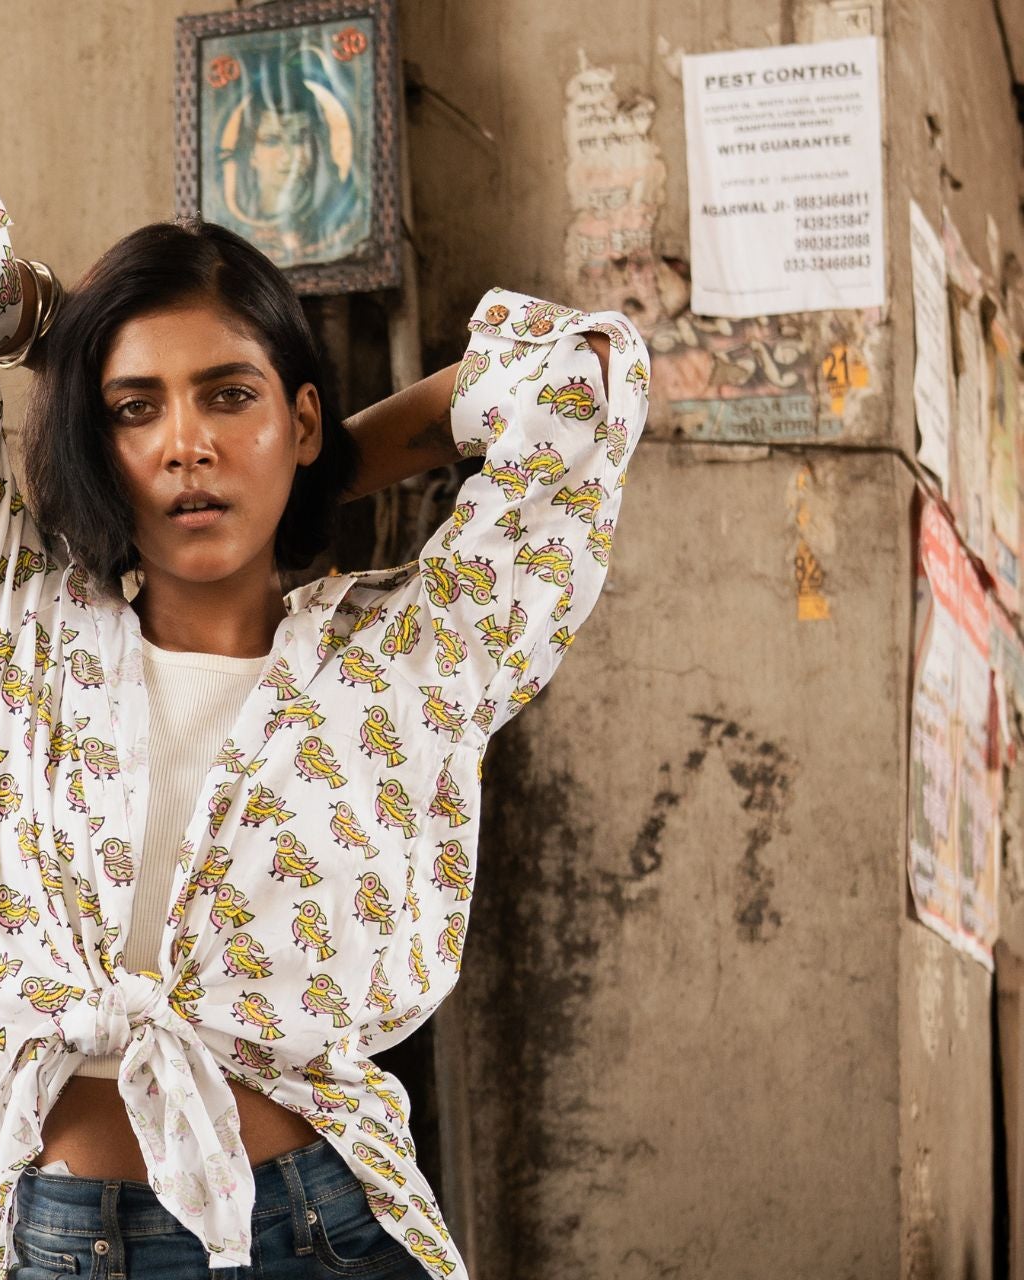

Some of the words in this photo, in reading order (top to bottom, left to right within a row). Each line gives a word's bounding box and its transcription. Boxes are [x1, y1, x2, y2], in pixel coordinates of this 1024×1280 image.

[705, 73, 756, 90] PEST
[763, 62, 862, 84] CONTROL
[718, 141, 756, 155] WITH
[760, 134, 852, 152] GUARANTEE
[701, 201, 767, 217] AGARWAL
[825, 351, 850, 383] 21
